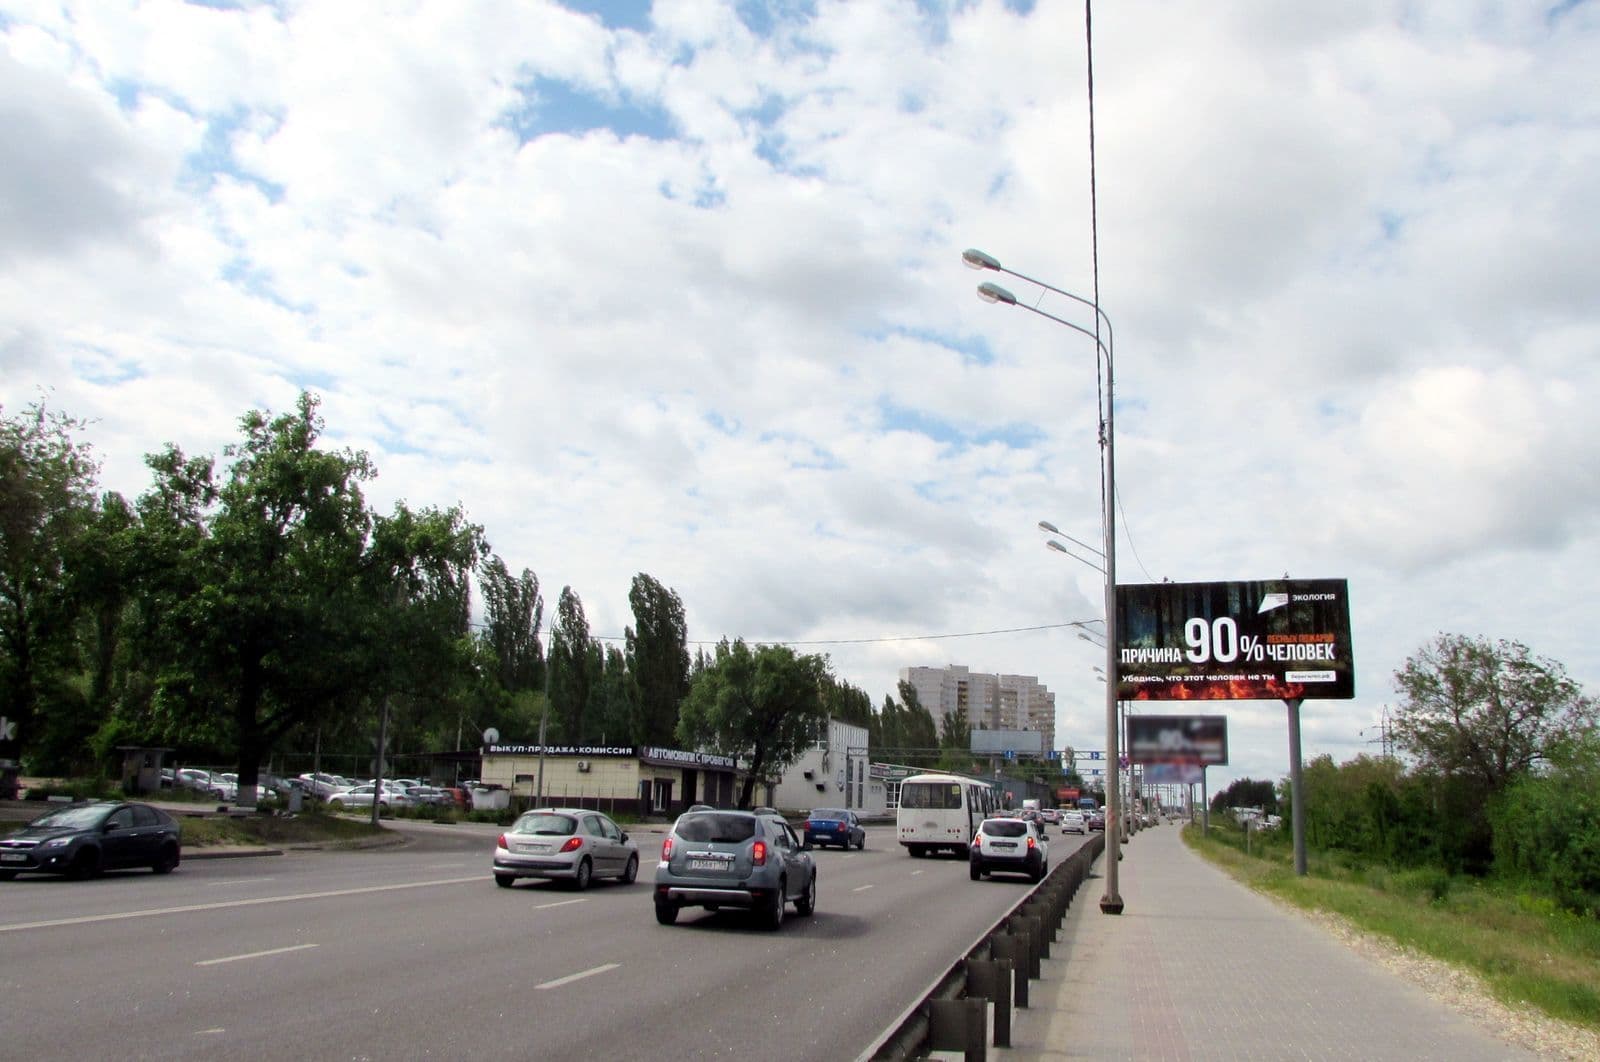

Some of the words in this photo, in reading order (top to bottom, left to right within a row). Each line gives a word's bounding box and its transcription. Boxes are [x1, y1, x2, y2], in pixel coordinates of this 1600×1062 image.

[1292, 593, 1335, 601] ЭКОЛОГИЯ
[1121, 648, 1182, 663] ПРИЧИНА
[1266, 643, 1335, 661] ЧЕЛОВЕК
[579, 746, 633, 755] КОМИССИЯ
